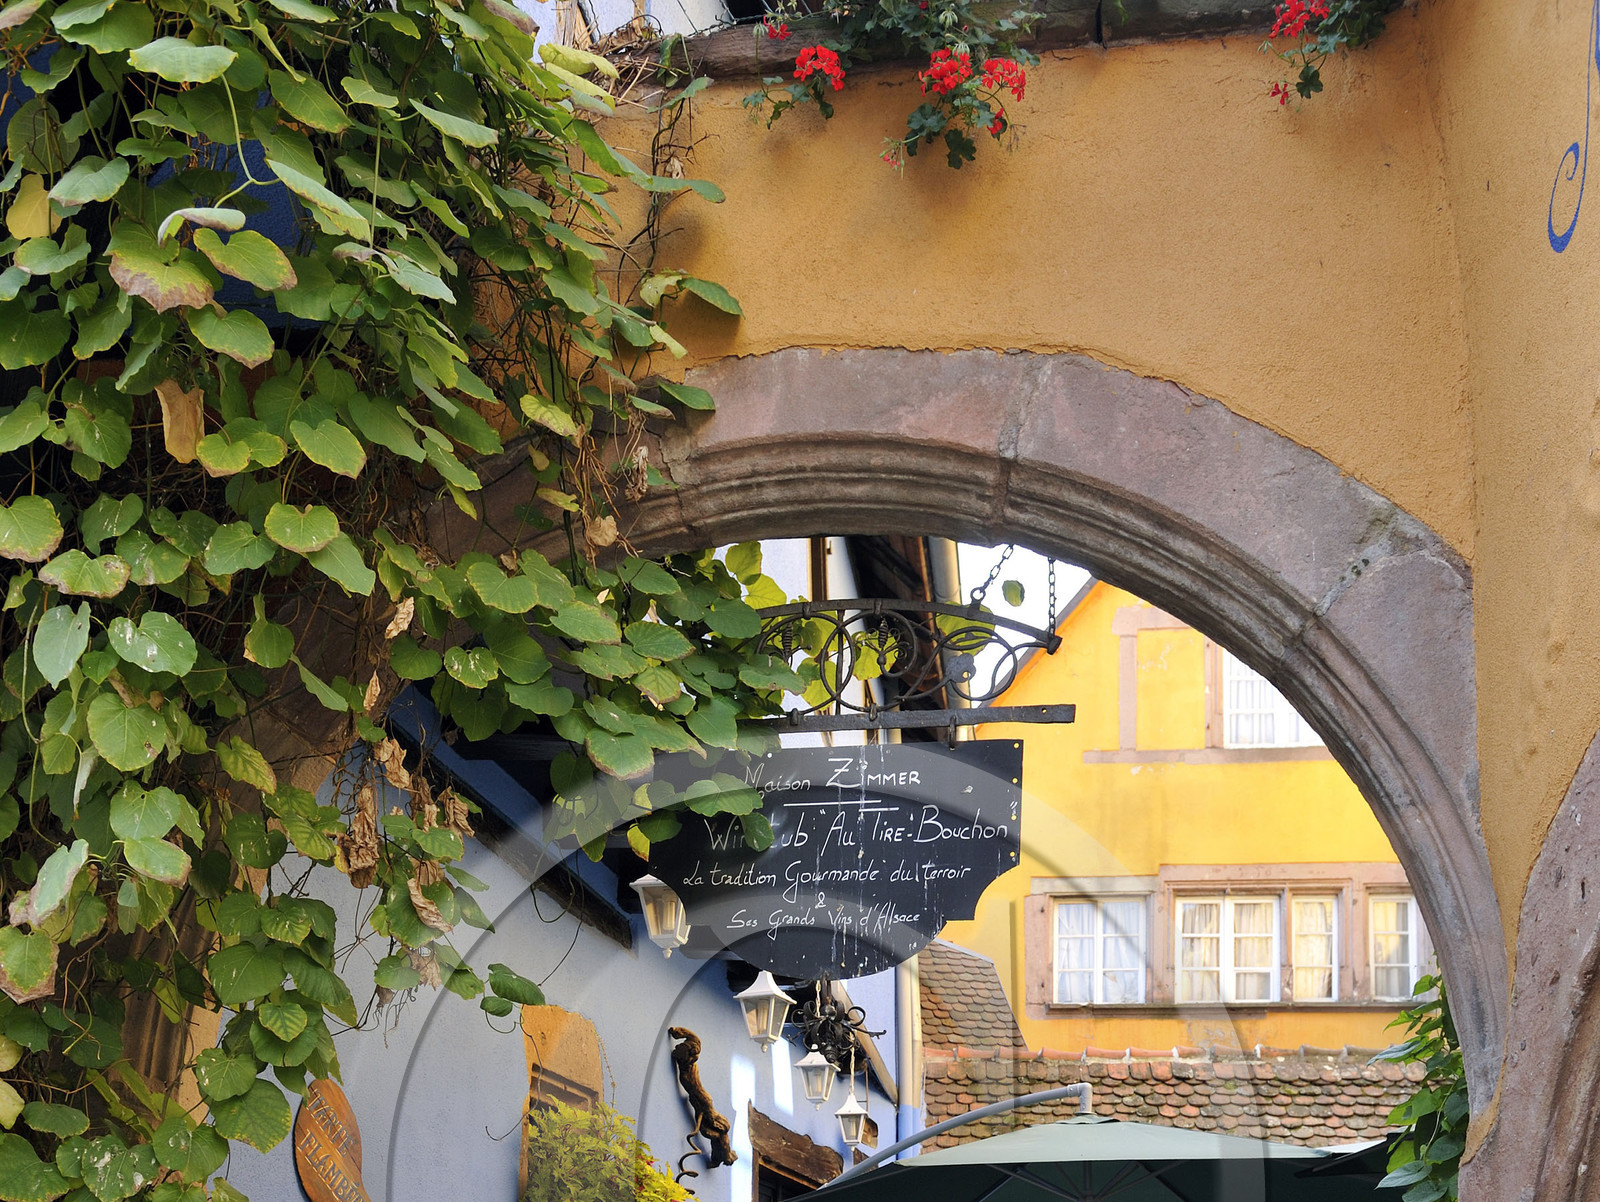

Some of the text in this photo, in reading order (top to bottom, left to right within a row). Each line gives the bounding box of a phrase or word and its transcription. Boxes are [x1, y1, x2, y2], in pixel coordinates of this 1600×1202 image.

[744, 762, 811, 800] Maison
[710, 863, 776, 887] tradition
[782, 858, 880, 904] Gourmande
[890, 859, 914, 882] du
[921, 861, 971, 881] terroir
[815, 891, 827, 909] &
[726, 909, 758, 929] Ses
[767, 907, 816, 941] Grands
[828, 906, 853, 926] Vins
[306, 1088, 354, 1158] TARTE
